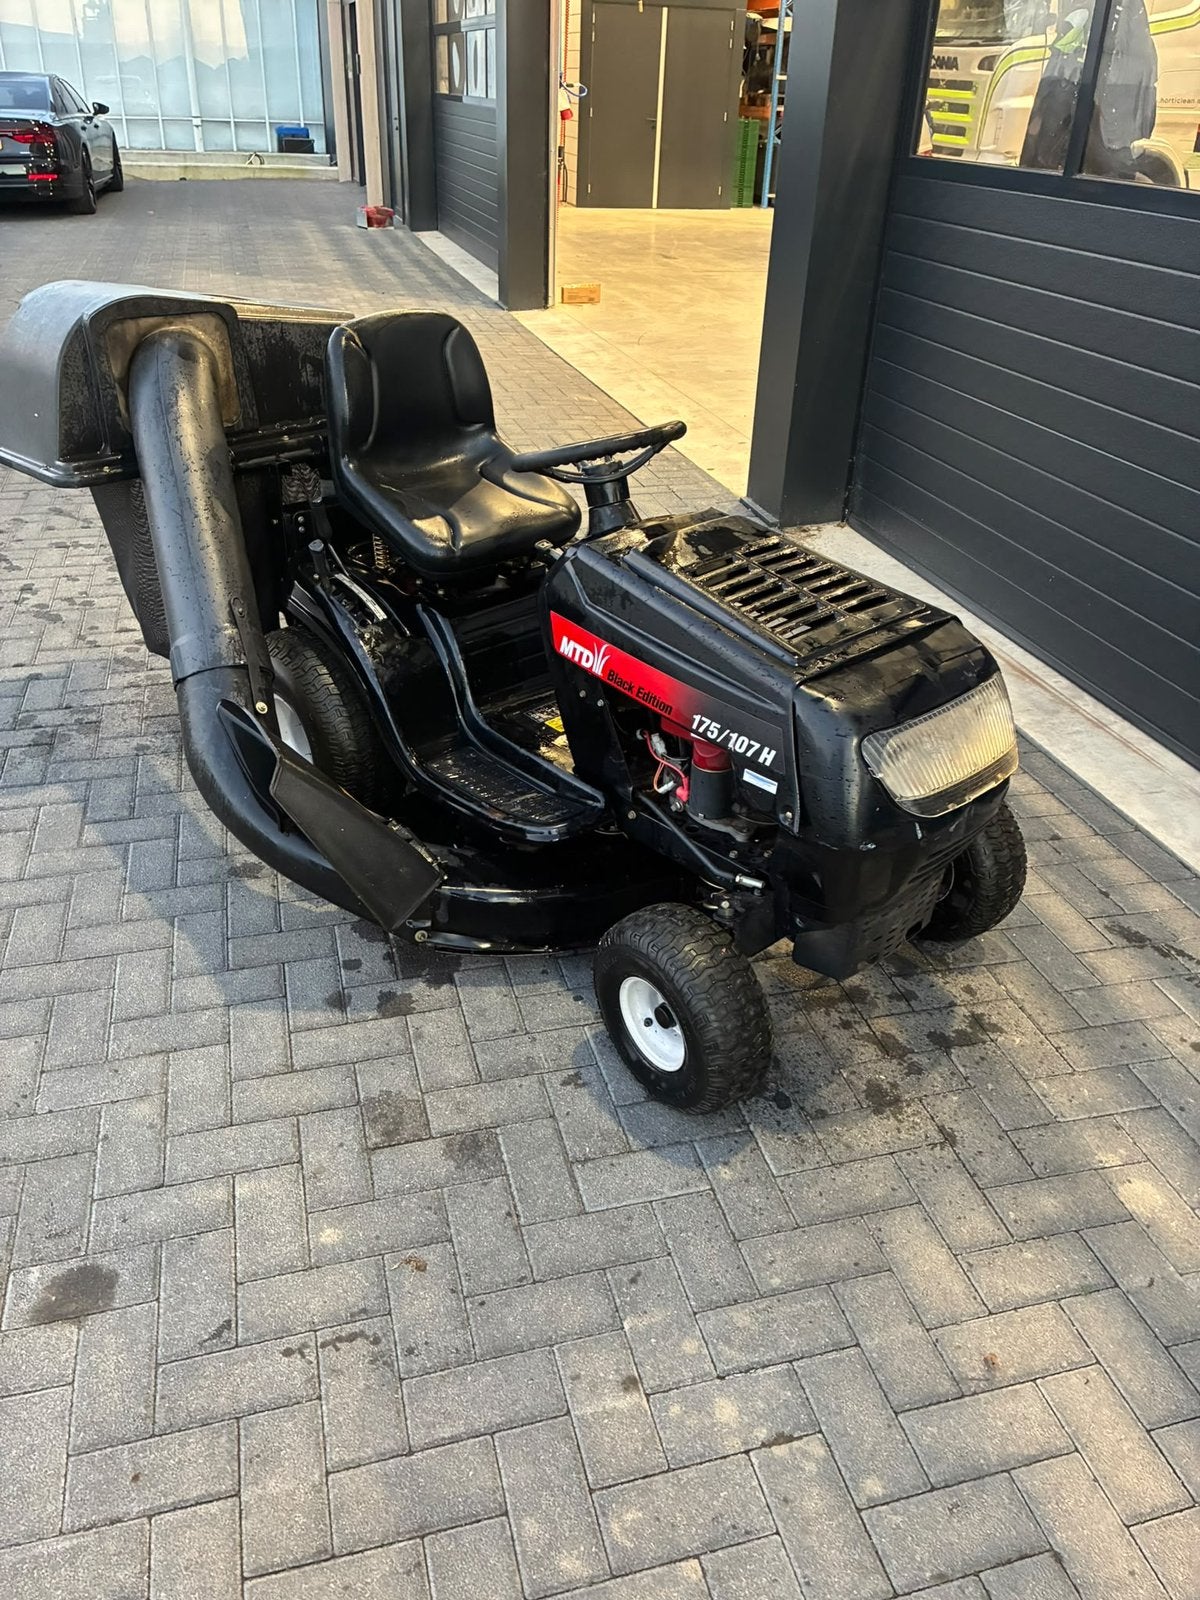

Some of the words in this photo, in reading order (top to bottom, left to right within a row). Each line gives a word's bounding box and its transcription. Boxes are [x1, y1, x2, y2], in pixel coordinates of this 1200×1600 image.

[560, 635, 594, 668] MTD
[607, 669, 634, 694] Black
[635, 686, 673, 715] Edition
[692, 714, 761, 758] 175/107
[757, 746, 777, 767] H
